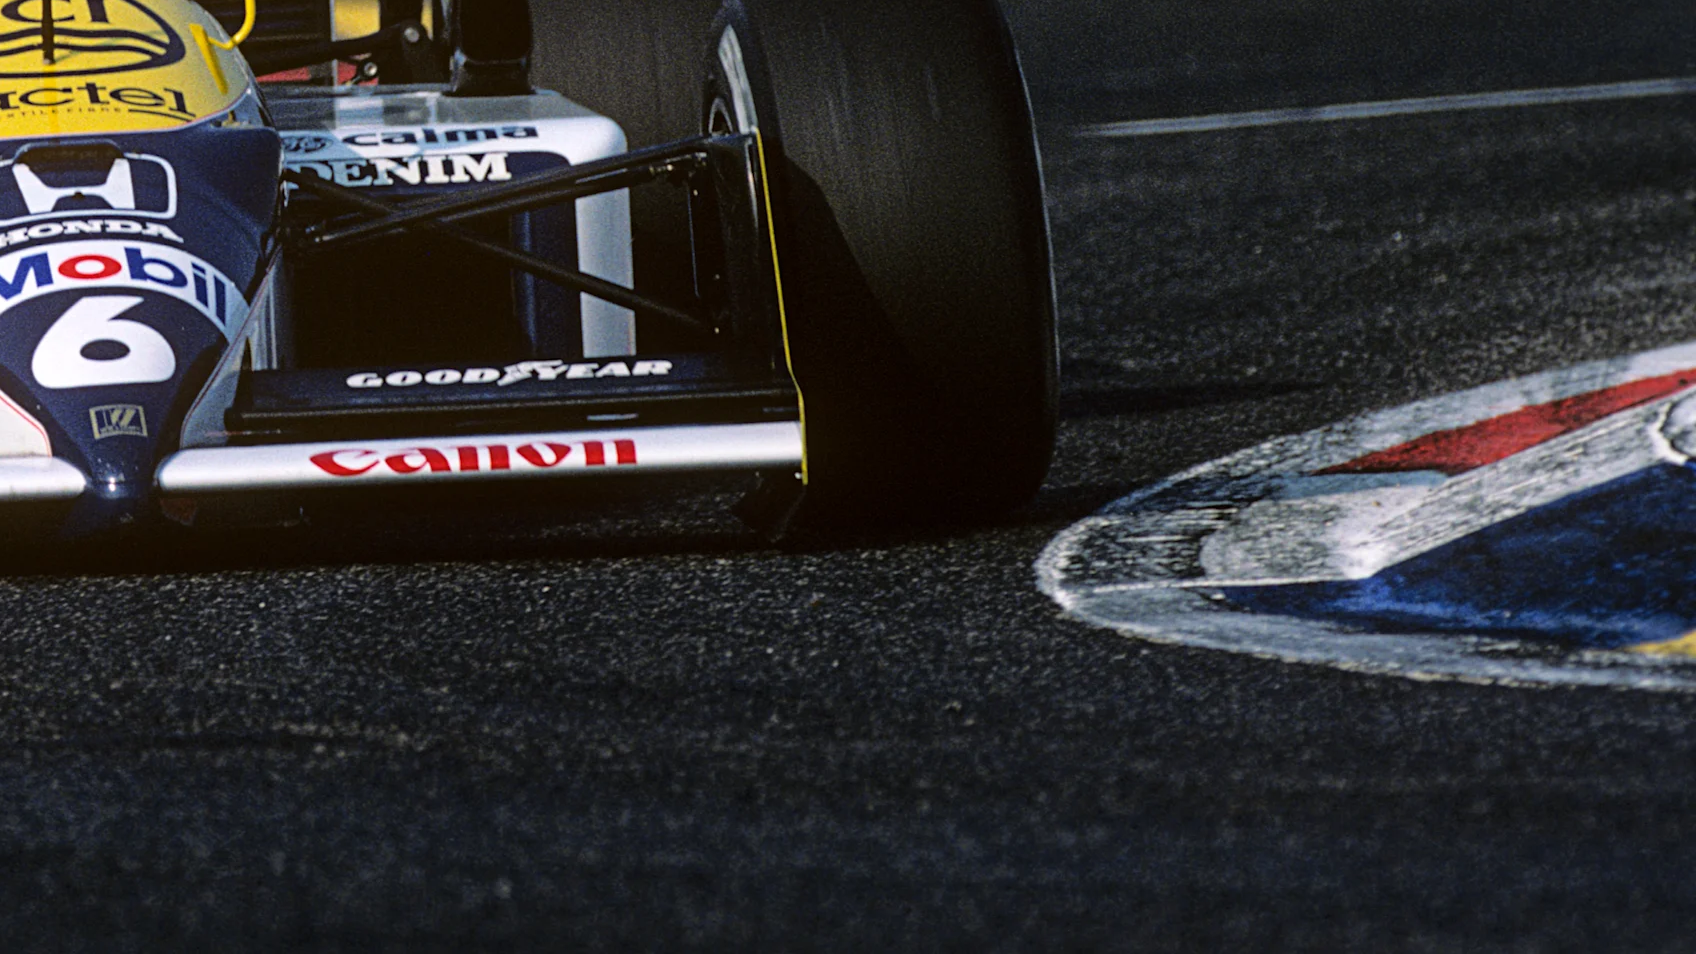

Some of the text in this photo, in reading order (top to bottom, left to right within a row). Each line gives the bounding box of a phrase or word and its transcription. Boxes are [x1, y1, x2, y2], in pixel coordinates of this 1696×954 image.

[342, 126, 539, 147] calma
[31, 296, 177, 389] 6
[346, 359, 673, 387] GOODYEAR
[309, 438, 638, 477] Canon
